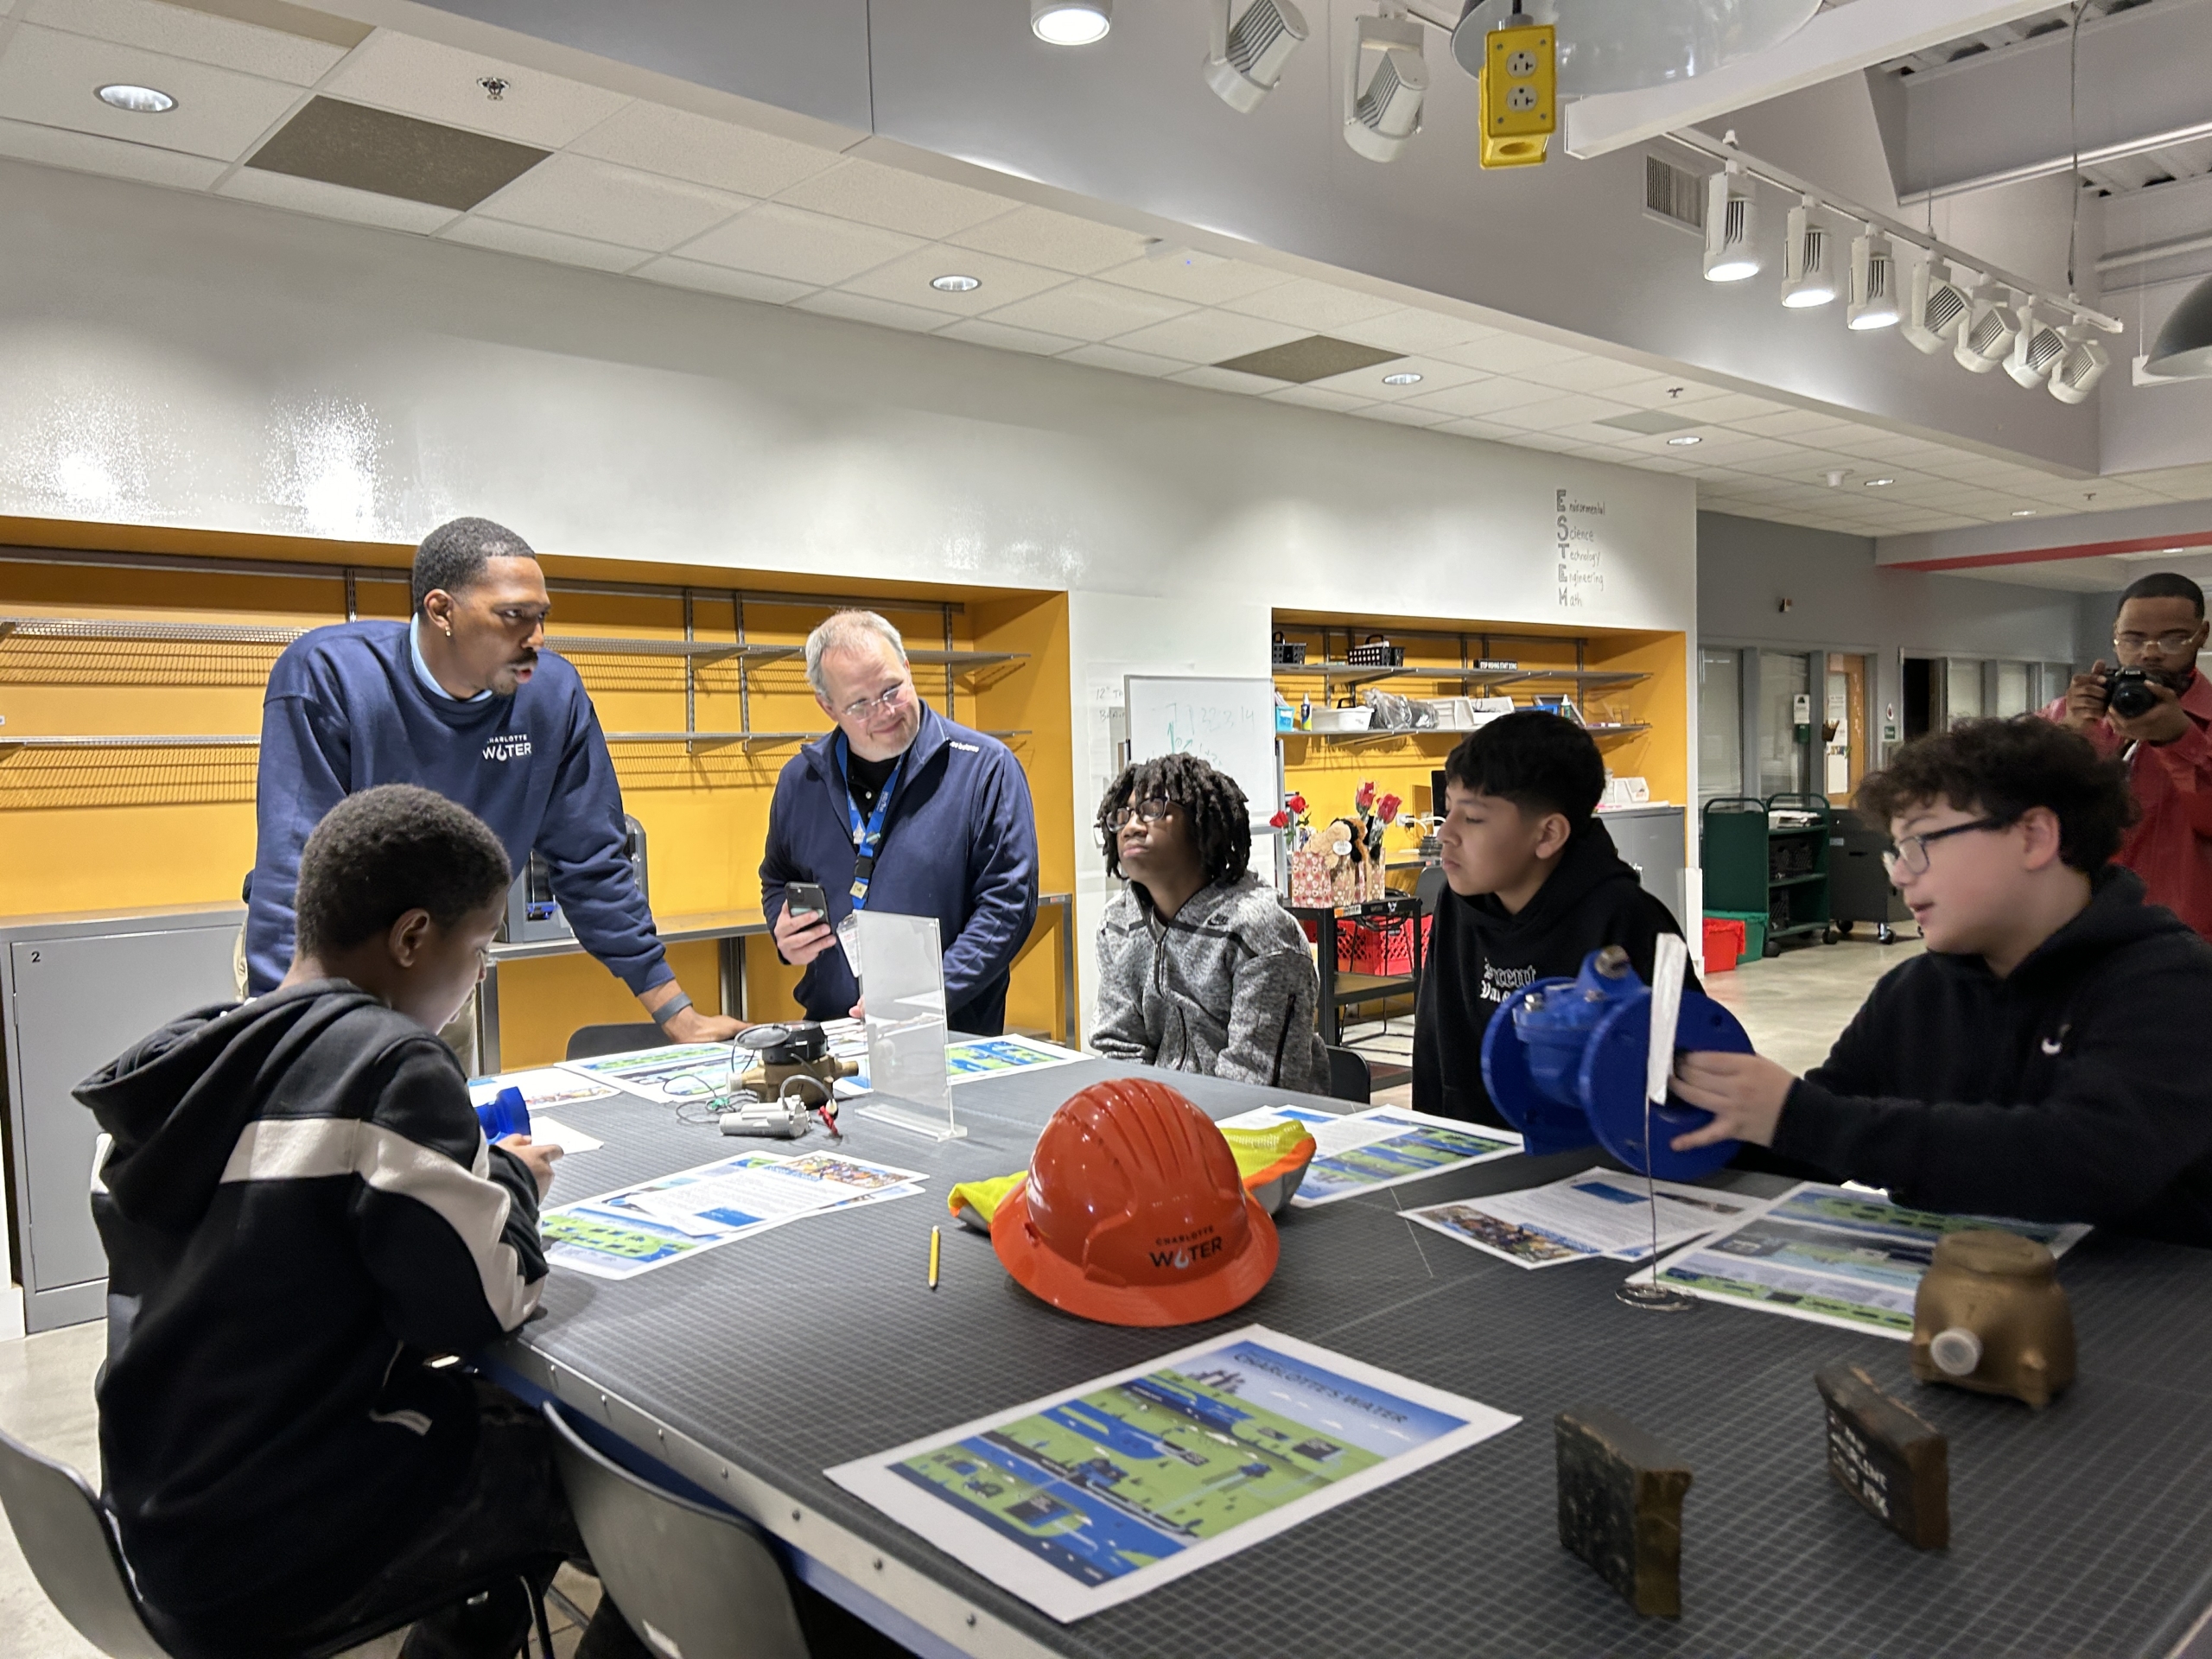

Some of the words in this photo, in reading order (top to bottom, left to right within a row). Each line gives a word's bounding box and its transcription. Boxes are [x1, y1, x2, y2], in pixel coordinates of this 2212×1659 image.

[1556, 514, 1594, 543] Science
[1558, 543, 1600, 568] Technology
[1558, 563, 1604, 592] Engineering
[1559, 587, 1582, 607] Math
[487, 734, 527, 744] HARLOTTE
[31, 950, 41, 963] 2
[1155, 1224, 1214, 1247] CHARLOTTE
